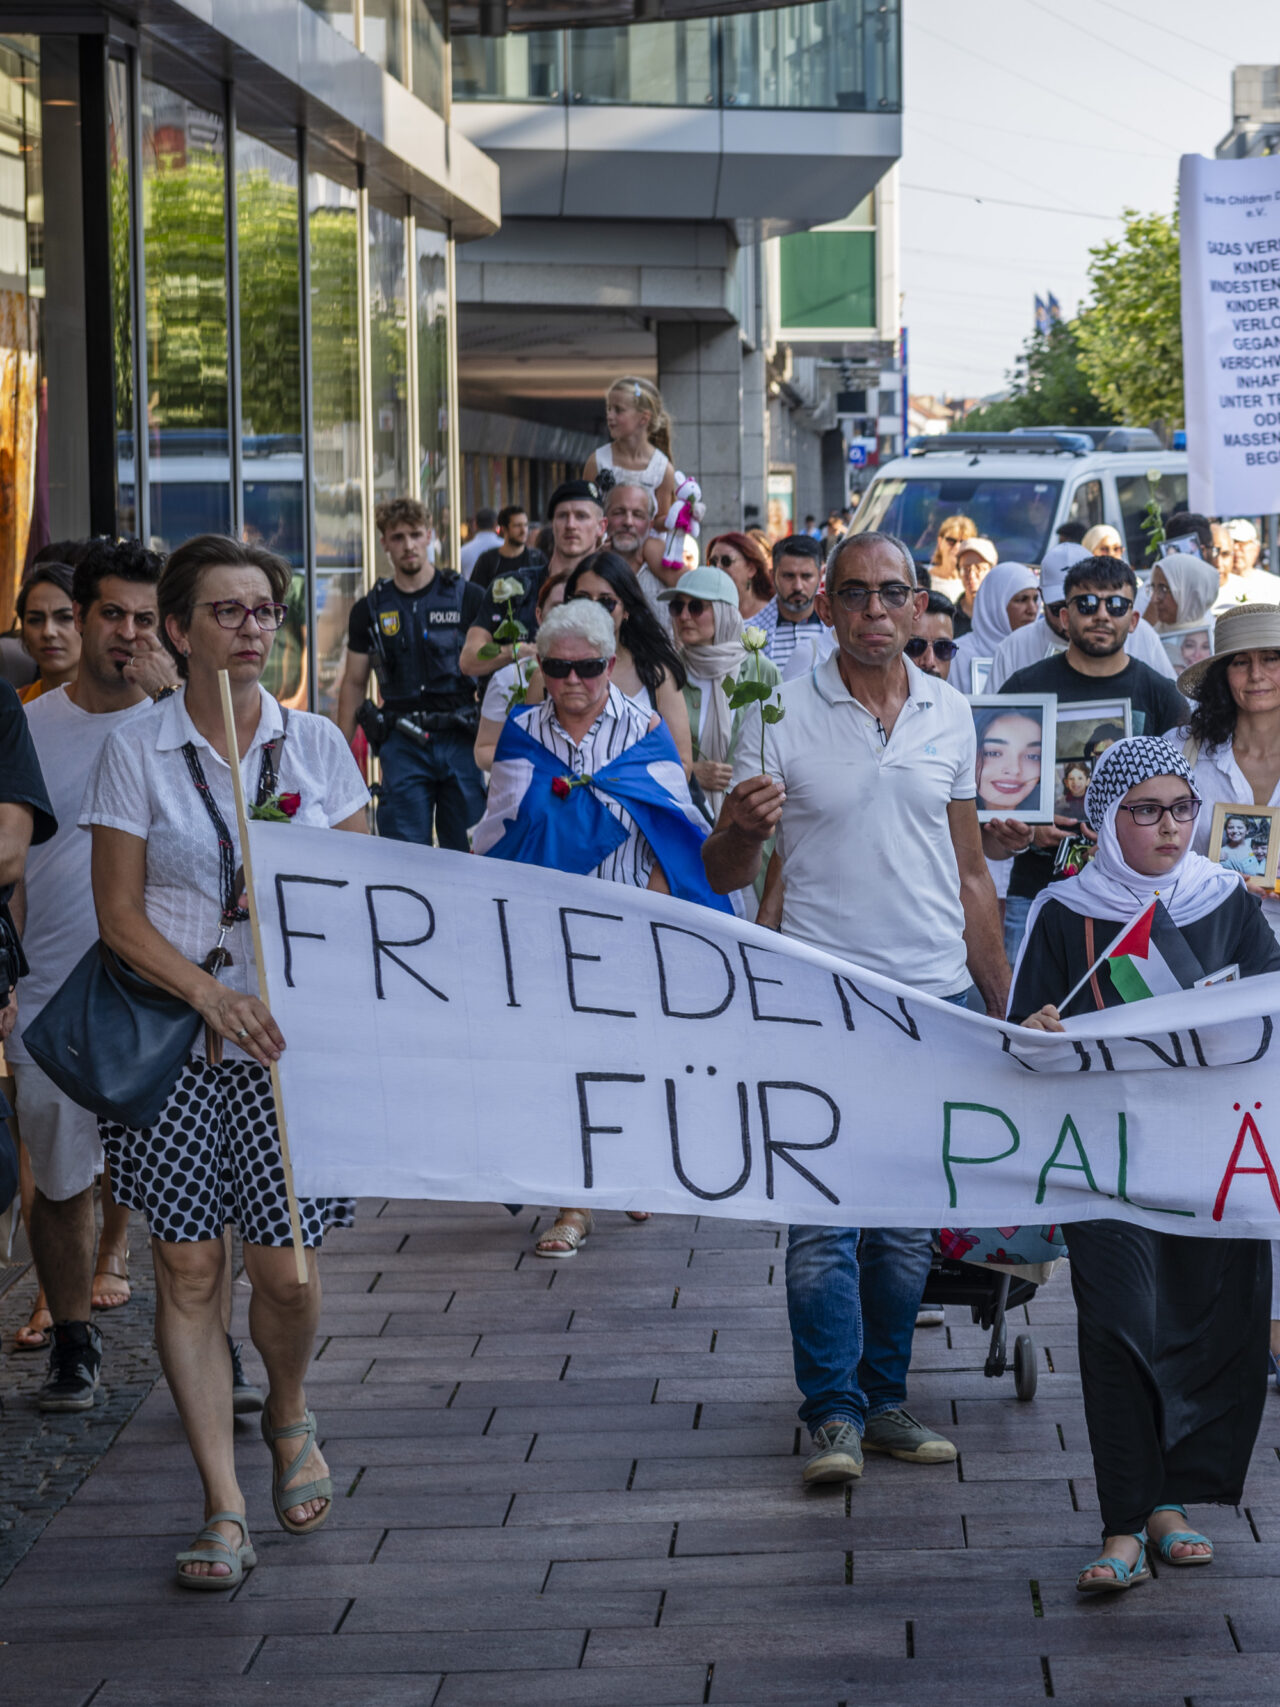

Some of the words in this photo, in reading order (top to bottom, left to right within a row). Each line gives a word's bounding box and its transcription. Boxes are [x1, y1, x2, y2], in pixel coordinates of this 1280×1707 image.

[1228, 192, 1273, 206] Children
[1245, 207, 1268, 219] e.V.
[1226, 293, 1280, 313] KINDER
[1219, 394, 1263, 409] UNTER
[429, 611, 461, 623] POLIZEI
[275, 873, 922, 1042] FRIEDEN
[575, 1064, 840, 1205] FÜR
